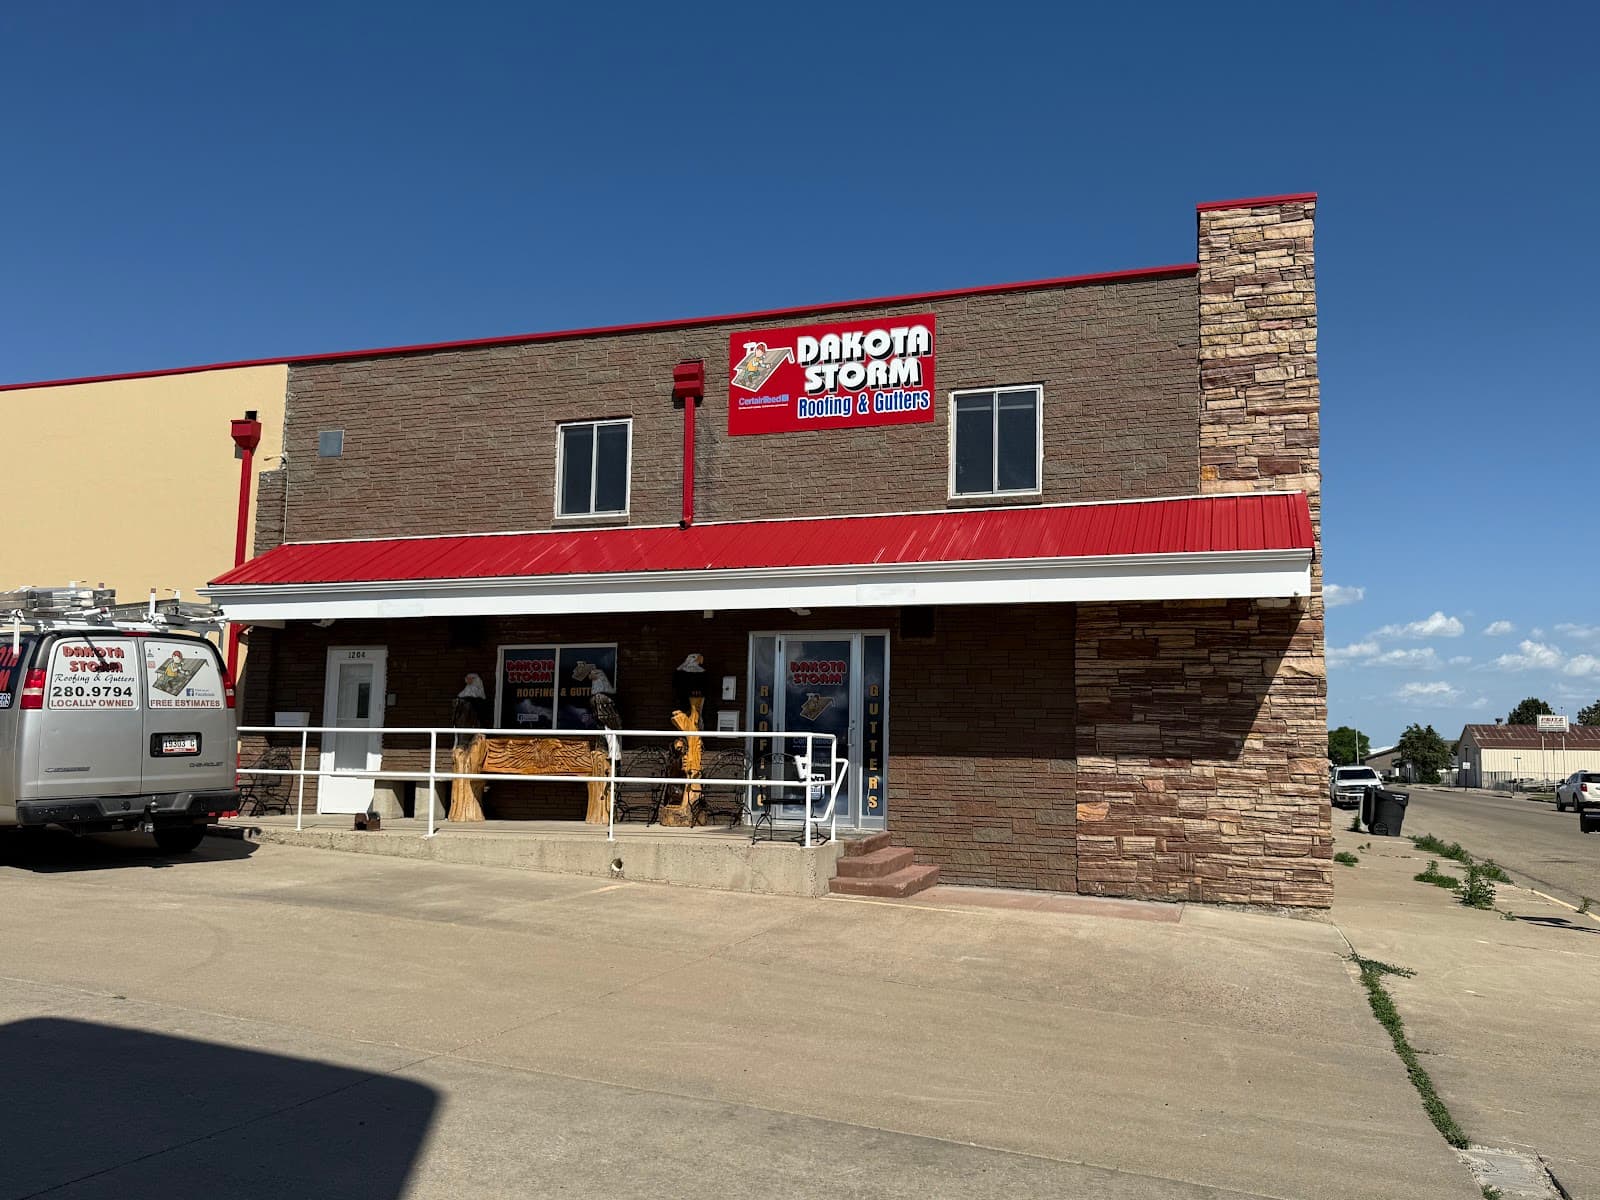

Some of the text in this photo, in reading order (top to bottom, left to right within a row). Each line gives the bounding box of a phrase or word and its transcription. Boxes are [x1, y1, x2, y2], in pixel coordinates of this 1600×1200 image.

[797, 325, 932, 367] DAKOTA
[804, 357, 922, 395] STORM
[797, 390, 930, 419] Roofing & Gutters
[62, 645, 125, 659] DAKOTA
[69, 660, 124, 673] STORM
[506, 660, 555, 672] DAKOTA
[789, 660, 846, 673] DAKOTA
[54, 672, 135, 684] Roofing & Gutters
[508, 671, 552, 683] STORM
[793, 673, 843, 685] STORM
[52, 686, 133, 697] 280.9794
[516, 687, 554, 697] ROOFING
[570, 687, 592, 697] GUTT
[51, 699, 134, 707] LOCALLY OWNED
[150, 699, 220, 707] FREE ESTIMATES
[868, 684, 879, 809] GUTTERS
